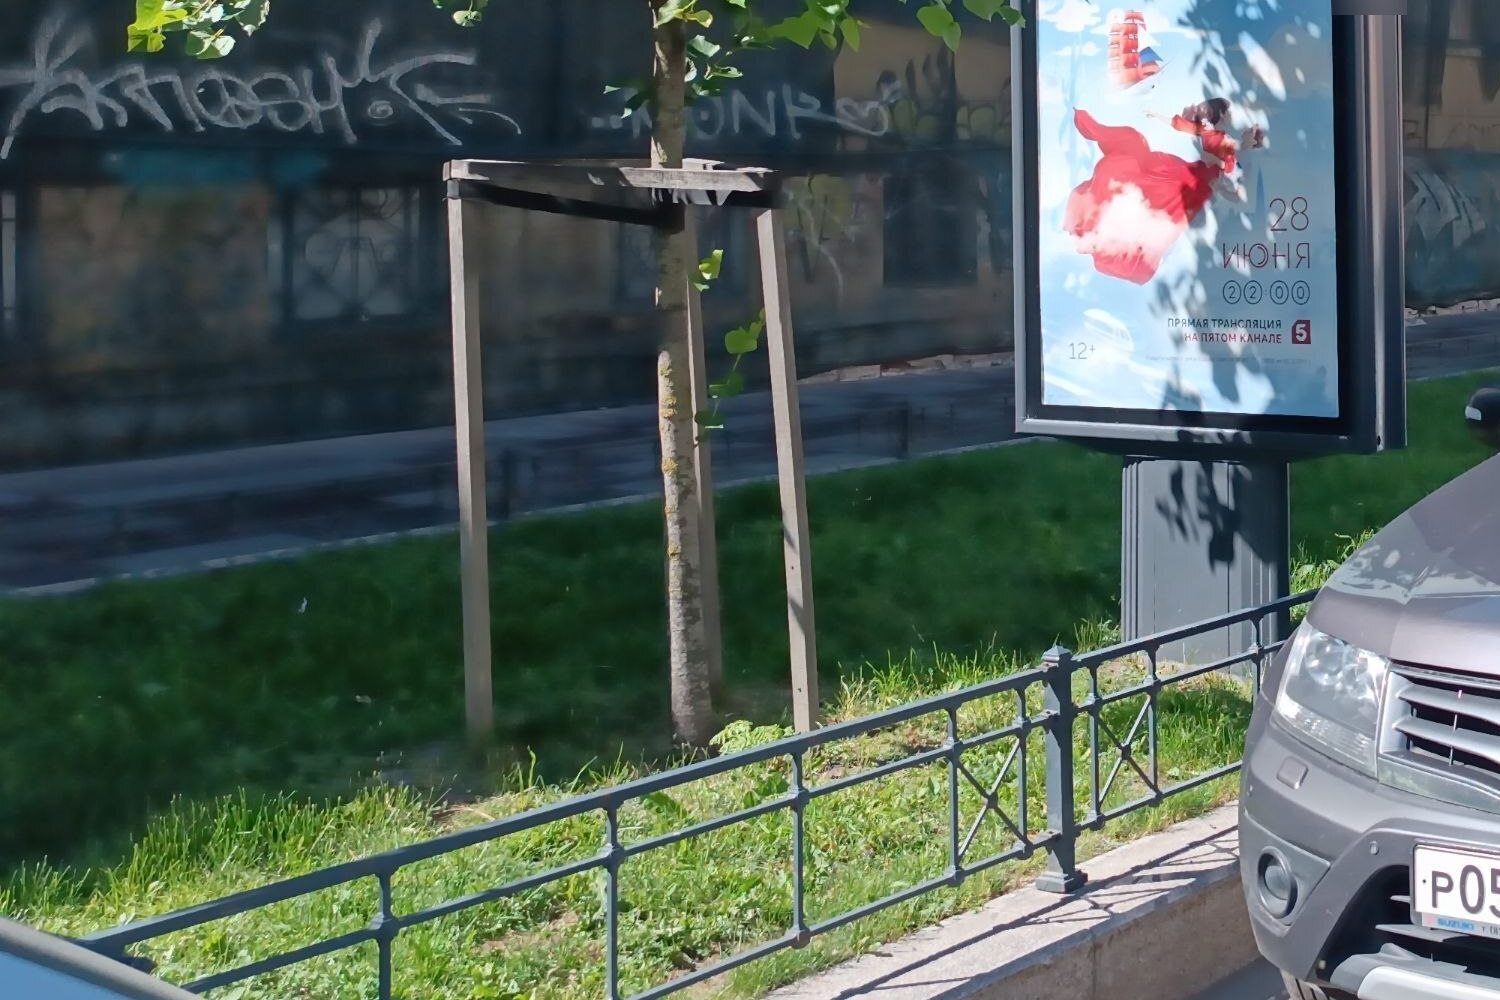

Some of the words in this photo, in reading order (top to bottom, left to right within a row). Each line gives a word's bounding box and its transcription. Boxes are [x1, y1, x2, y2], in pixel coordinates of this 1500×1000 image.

[1269, 196, 1309, 231] 28
[1222, 242, 1310, 269] ИЮНЯ
[1167, 317, 1209, 329] ПРЯМАЯ
[1211, 318, 1282, 330] ТРАНСЛЯЦИЯ
[1184, 333, 1198, 343] НА
[1200, 333, 1237, 343] ПЯТОМ
[1239, 333, 1282, 344] КАНАЛЕ
[1069, 341, 1096, 360] 12+
